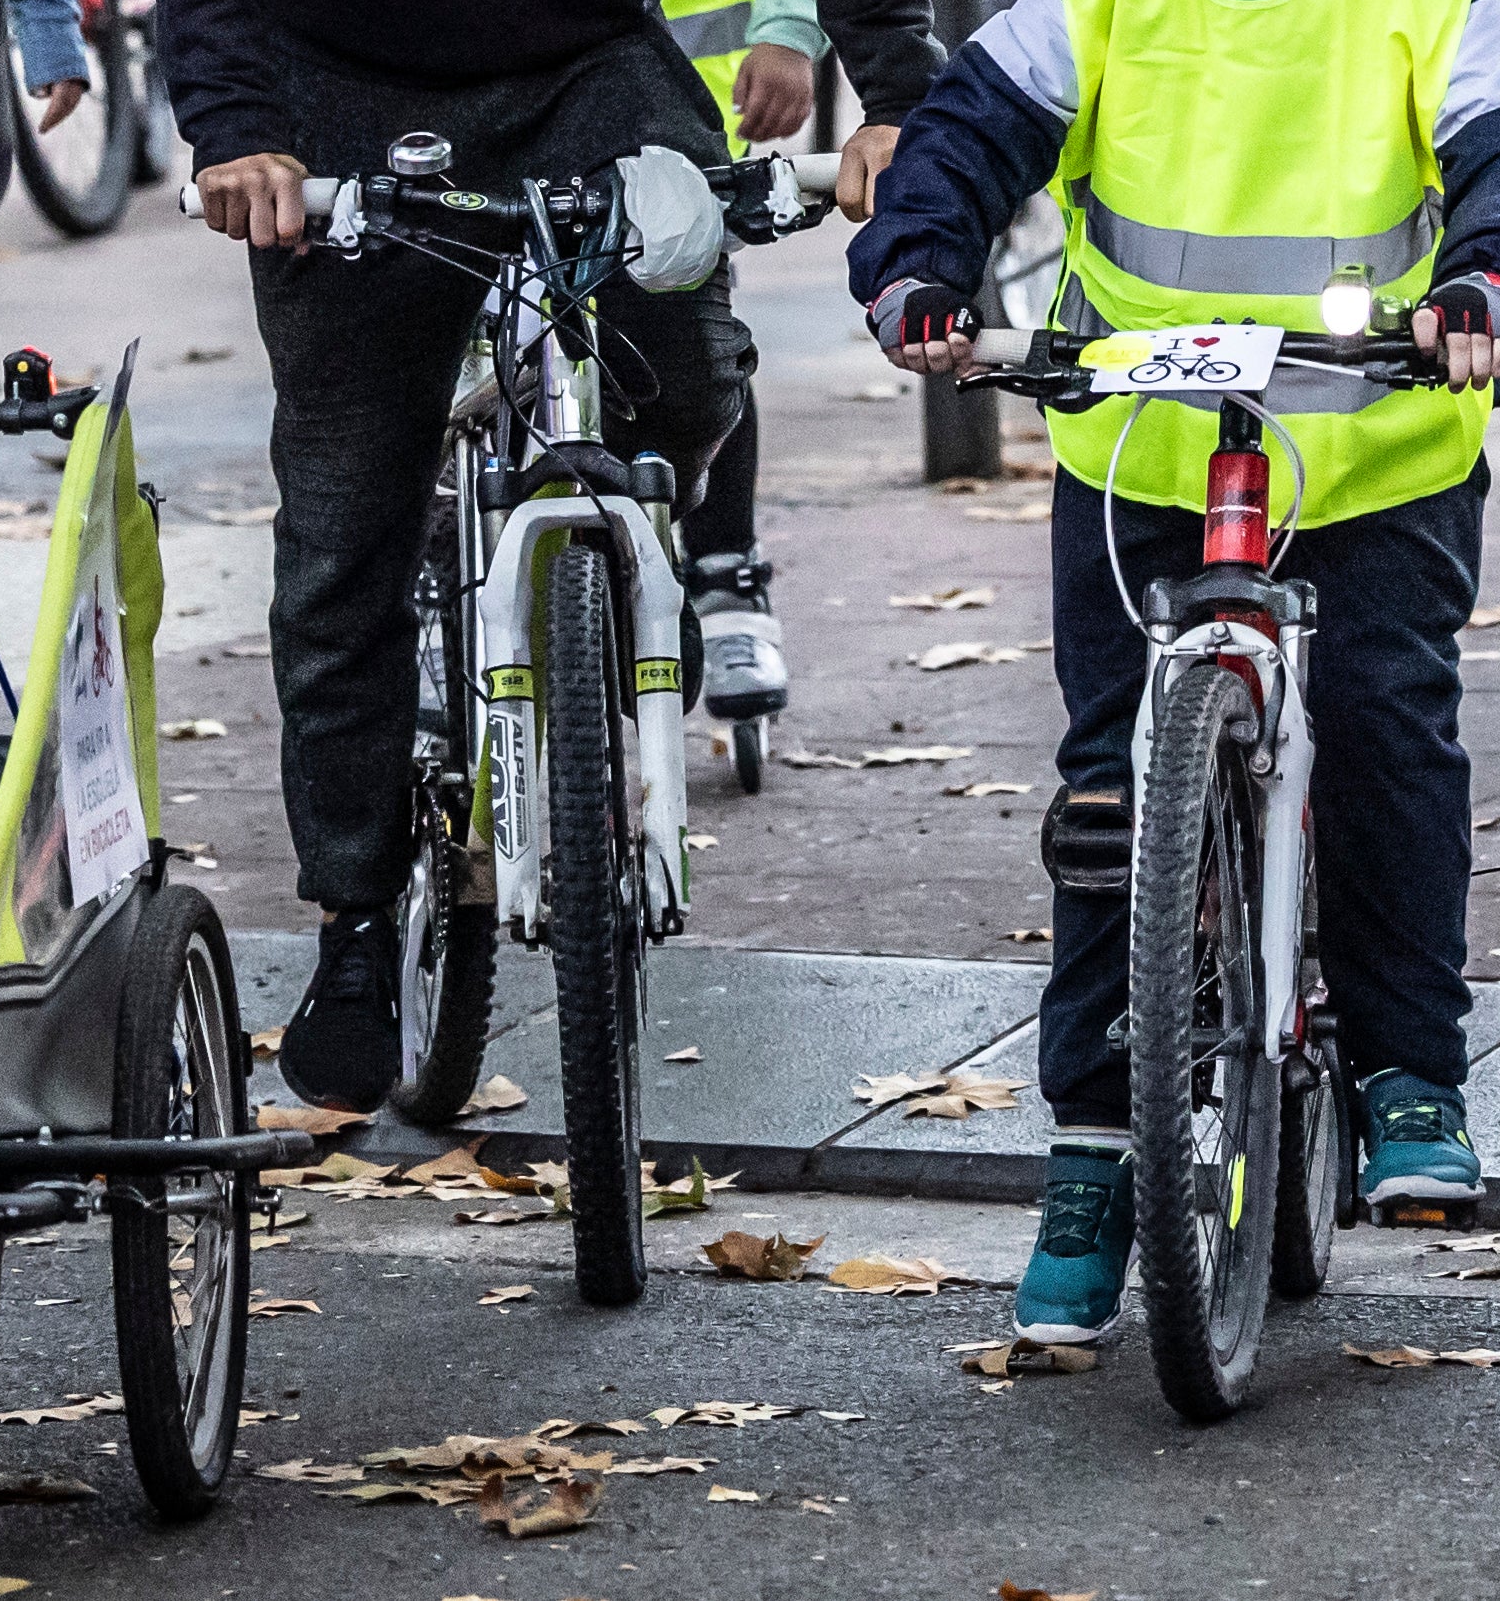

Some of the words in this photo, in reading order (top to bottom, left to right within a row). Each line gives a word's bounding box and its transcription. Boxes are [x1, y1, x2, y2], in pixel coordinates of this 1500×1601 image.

[641, 668, 670, 679] FOX
[513, 719, 525, 796] ALPS
[91, 807, 133, 858] BICICLETA
